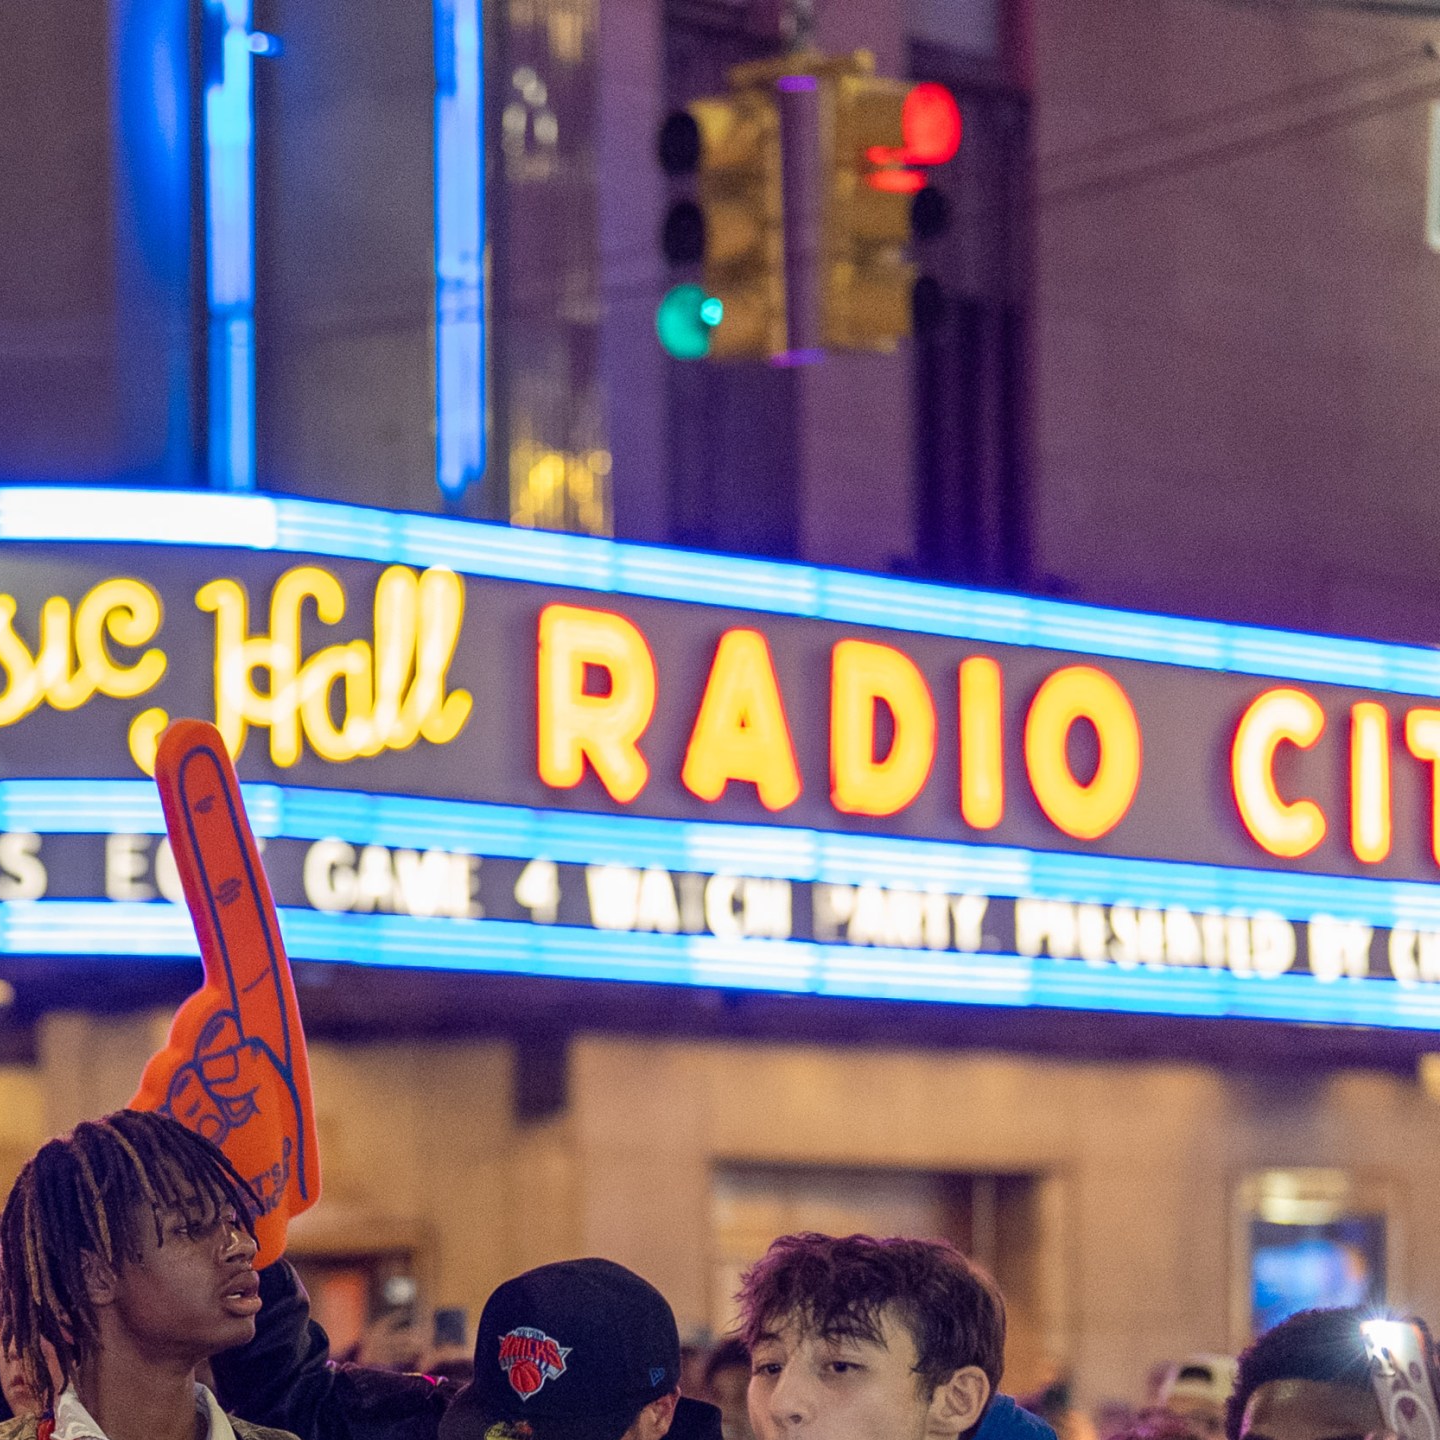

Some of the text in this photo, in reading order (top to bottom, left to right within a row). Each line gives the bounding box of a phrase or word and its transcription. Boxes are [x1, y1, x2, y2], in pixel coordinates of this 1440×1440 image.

[127, 563, 473, 779] Hall
[536, 601, 1144, 841] RADIO
[302, 835, 487, 926] GAME
[513, 854, 559, 925] 4
[811, 880, 989, 955] PARTY
[498, 1335, 563, 1371] KNICKS
